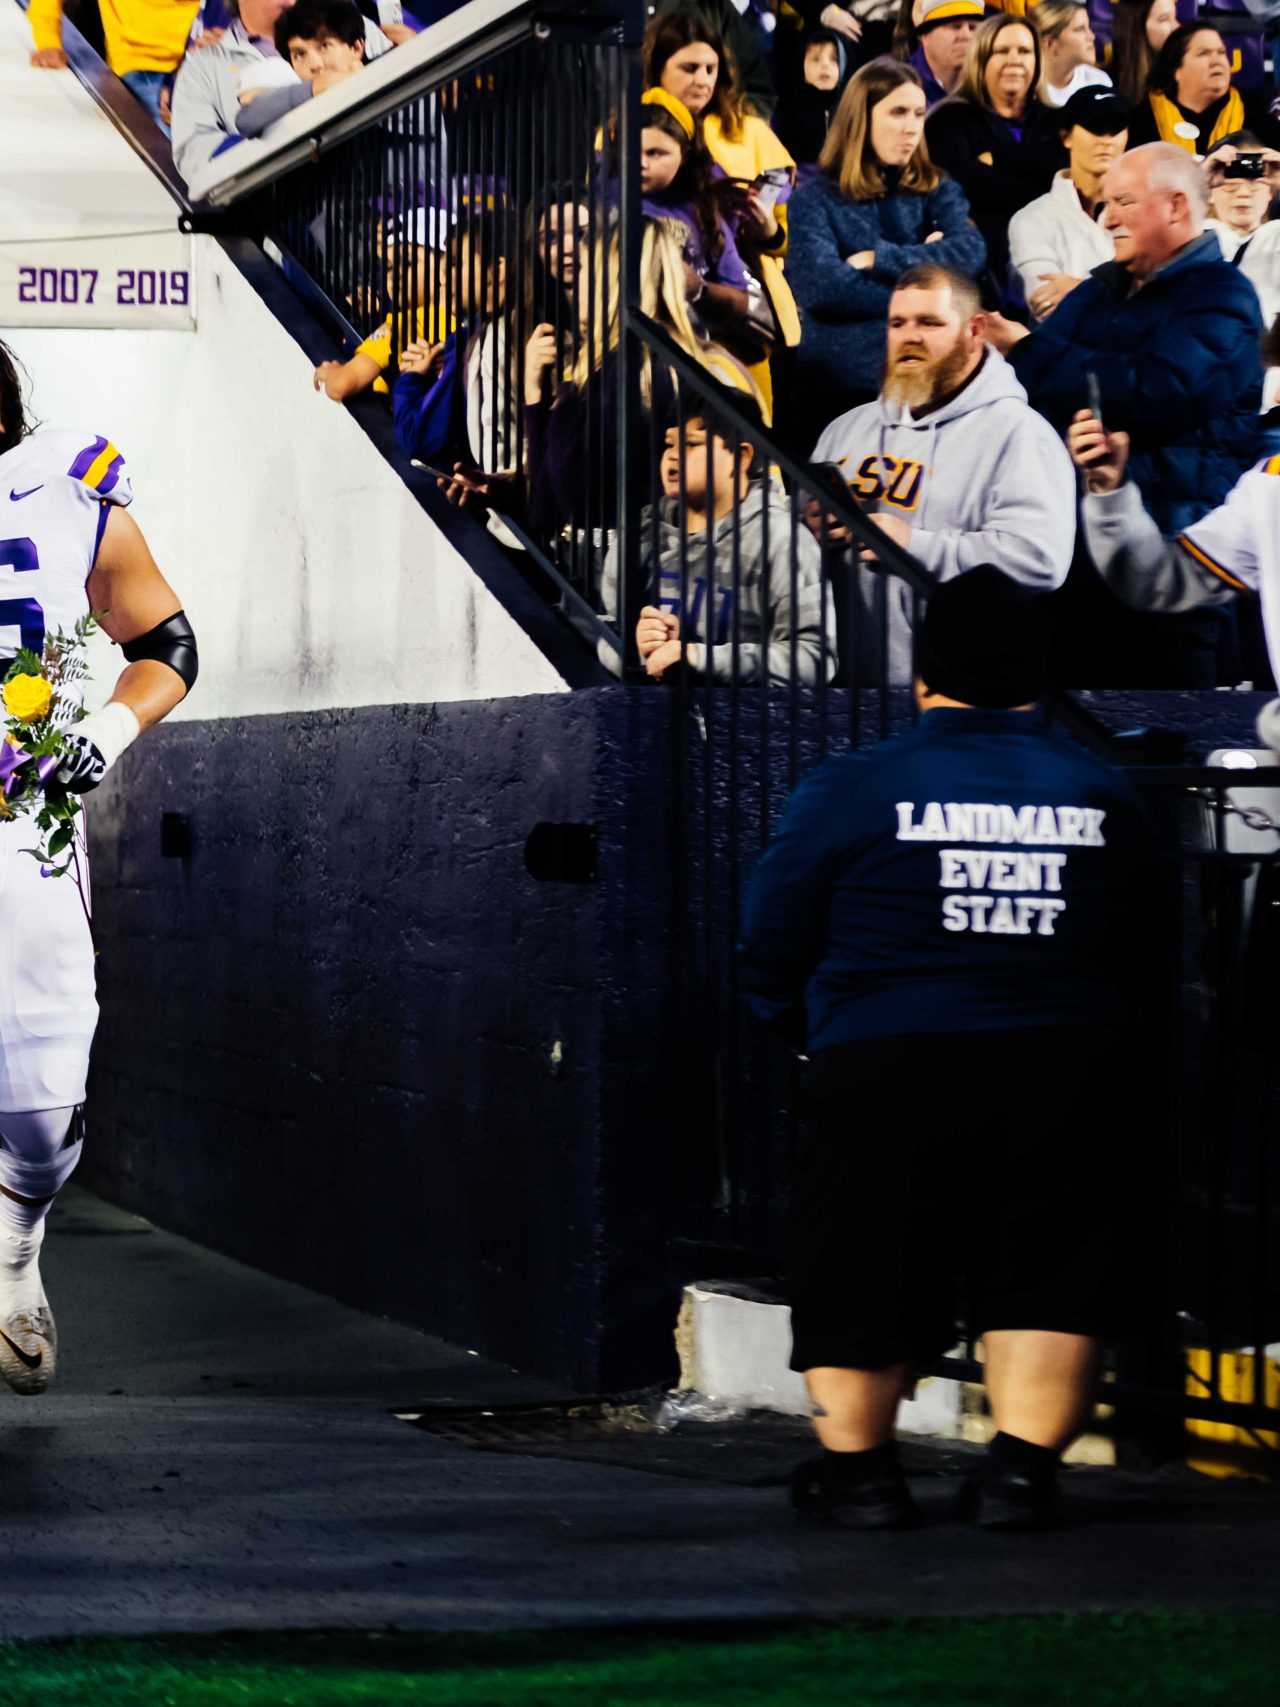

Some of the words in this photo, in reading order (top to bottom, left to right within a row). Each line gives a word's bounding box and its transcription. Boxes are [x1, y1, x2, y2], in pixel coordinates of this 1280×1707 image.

[19, 268, 99, 304] 2007
[118, 269, 190, 306] 2019
[837, 453, 927, 513] SU
[895, 801, 1107, 847] LANDMARK
[938, 849, 1068, 892] EVENT
[942, 894, 1067, 935] STAFF
